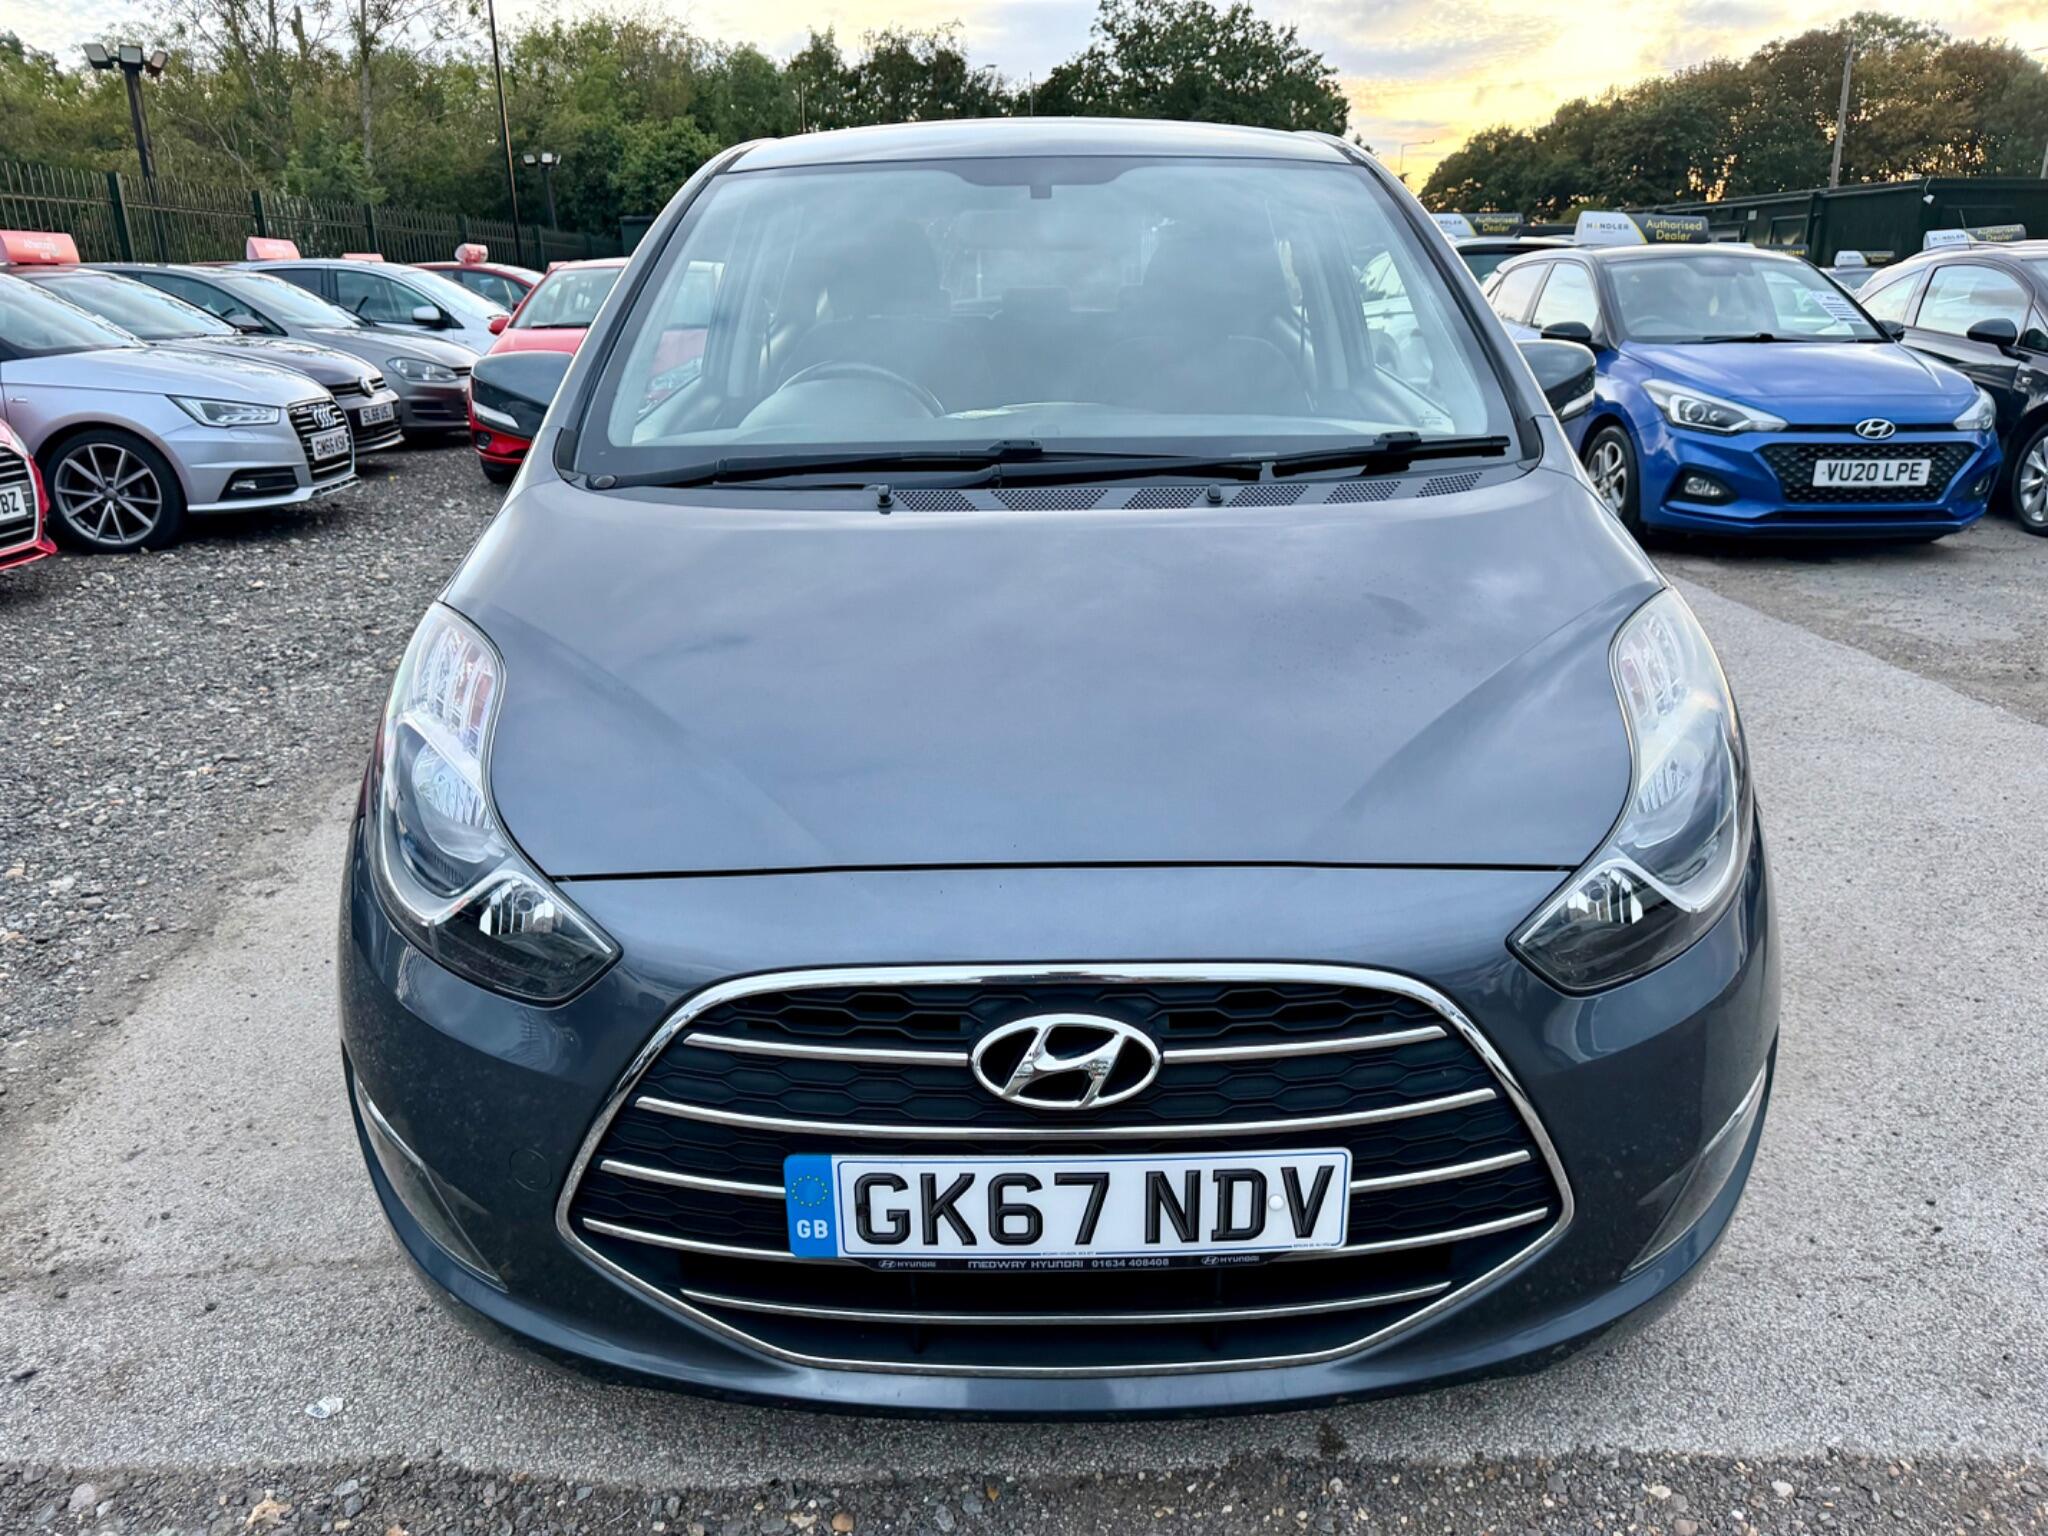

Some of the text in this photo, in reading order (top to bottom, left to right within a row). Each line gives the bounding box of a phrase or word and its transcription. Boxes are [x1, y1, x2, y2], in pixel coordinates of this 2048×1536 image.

[1474, 215, 1519, 224] Authorised
[1646, 219, 1703, 231] Authorised
[1482, 223, 1511, 233] Dealer
[1976, 225, 2021, 236] Authorised
[1655, 229, 1692, 241] Dealer
[1985, 233, 2014, 242] Dealer
[1827, 462, 1923, 482] VU20 LPE
[854, 1164, 1336, 1247] GK67 NDV
[796, 1219, 829, 1240] GB
[897, 1260, 937, 1269] HYUNDAI
[967, 1257, 1170, 1269] MEDWAY HYUNDAI 01634 408408
[1219, 1255, 1260, 1264] HYUNDAI
